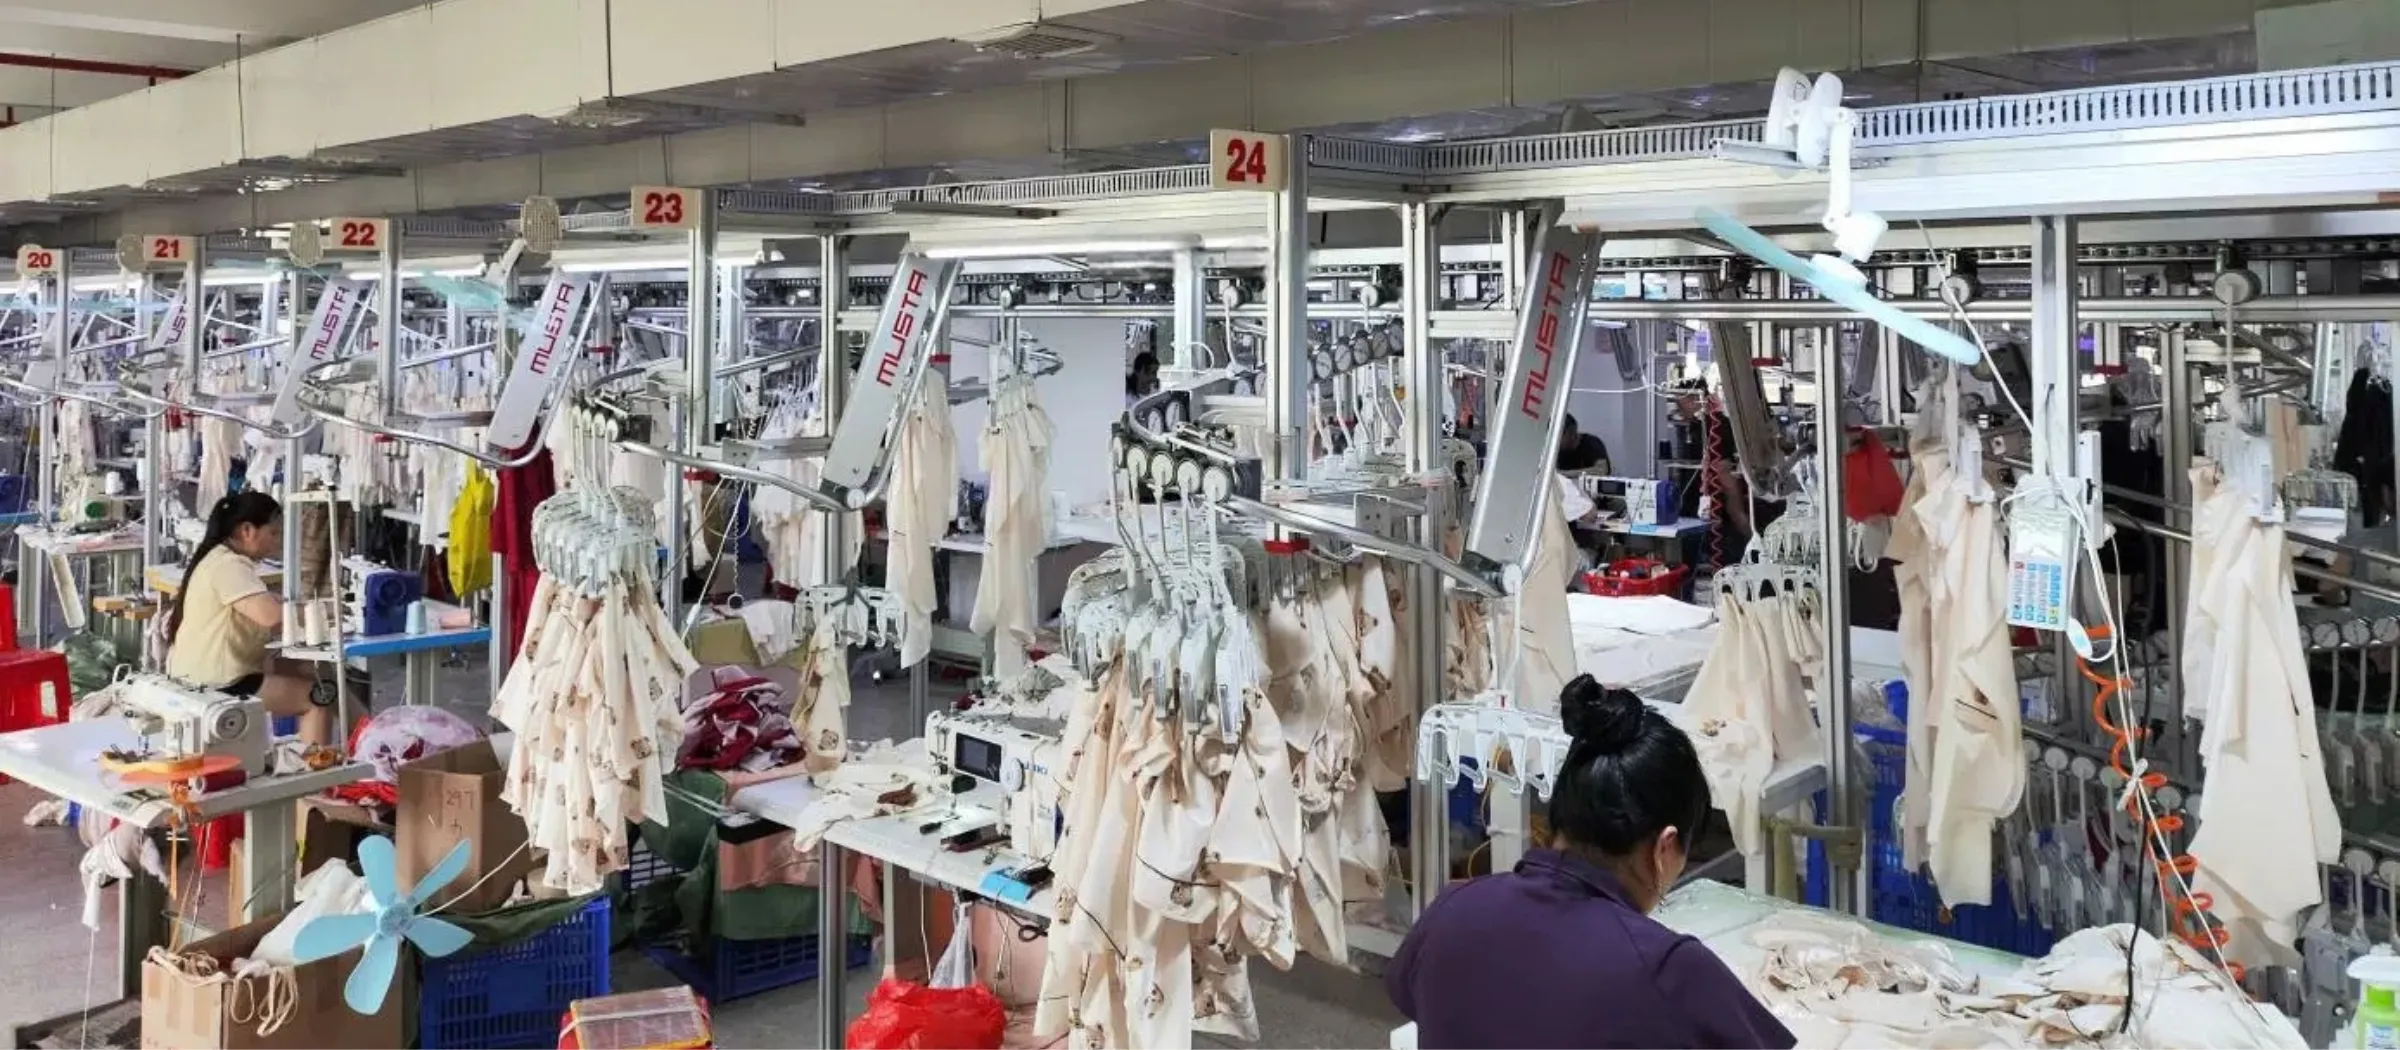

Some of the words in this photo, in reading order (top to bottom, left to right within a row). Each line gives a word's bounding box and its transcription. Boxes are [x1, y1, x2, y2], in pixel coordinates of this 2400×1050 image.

[1226, 138, 1267, 183] 24
[645, 192, 683, 223] 23
[154, 239, 180, 258] 21
[342, 222, 376, 246] 22
[27, 252, 52, 269] 20
[530, 282, 575, 375] MUSTA
[876, 268, 928, 387] MUSTA
[1521, 251, 1571, 421] MUSTA
